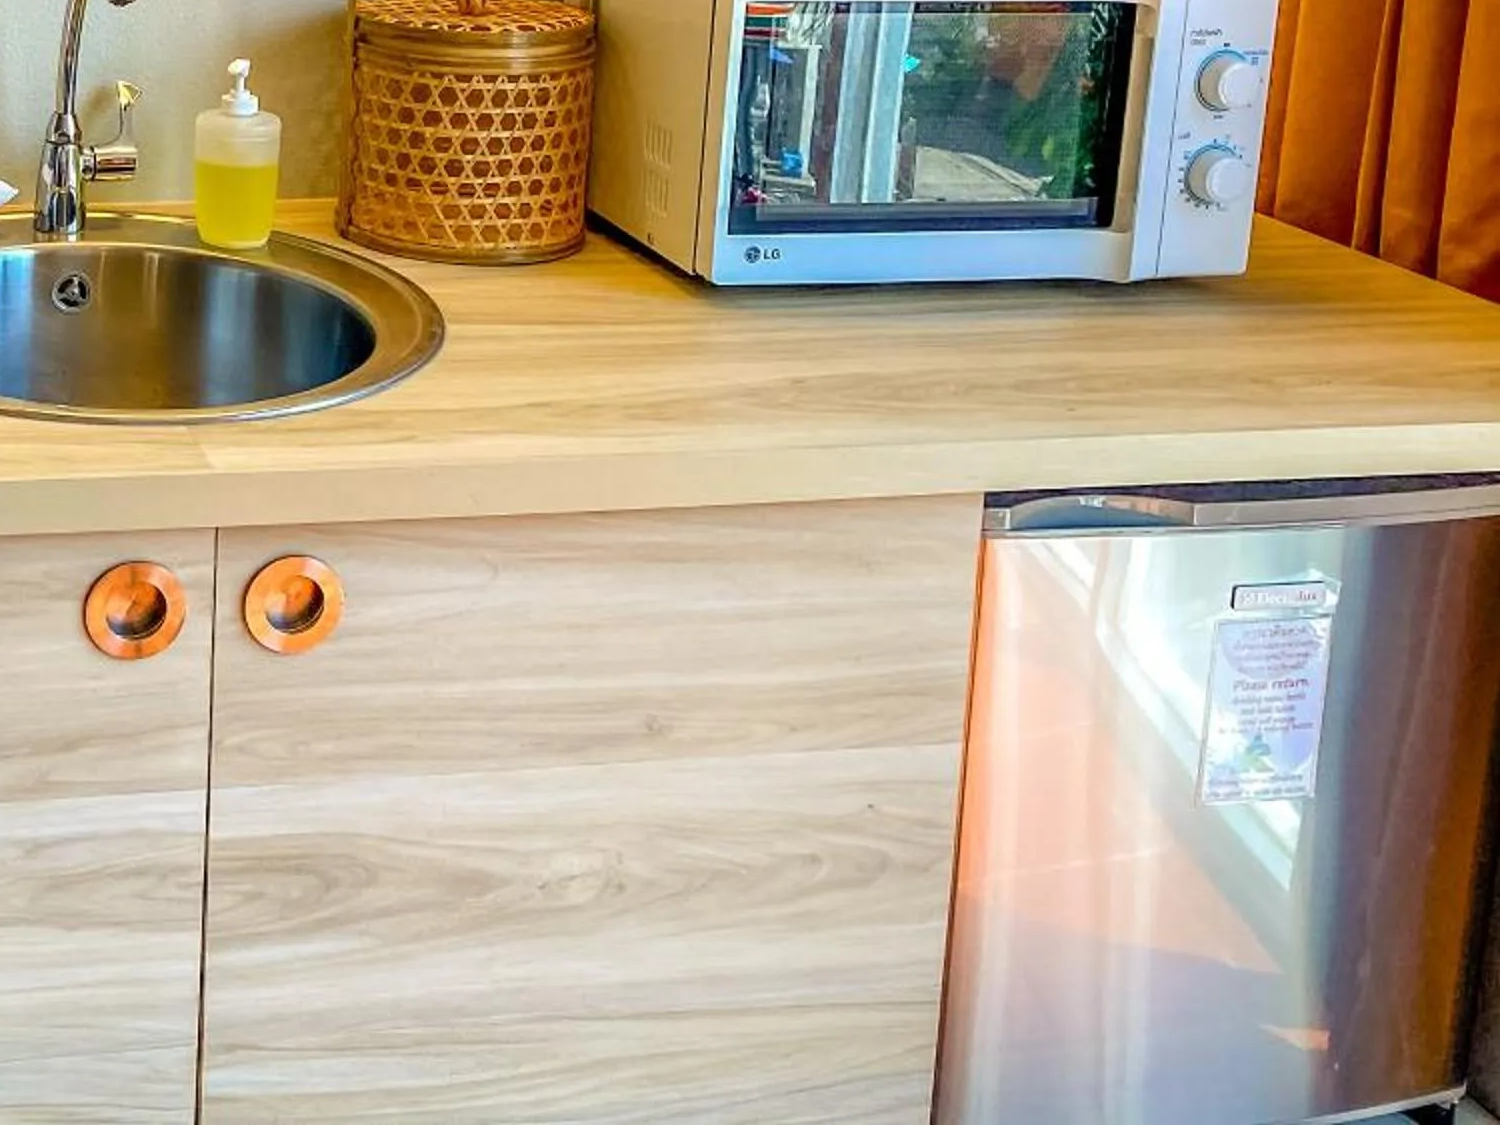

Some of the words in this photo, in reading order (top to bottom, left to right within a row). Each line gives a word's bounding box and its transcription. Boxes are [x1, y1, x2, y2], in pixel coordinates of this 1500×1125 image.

[763, 248, 781, 260] LG
[1257, 589, 1317, 605] Electlux
[1271, 677, 1310, 689] return
